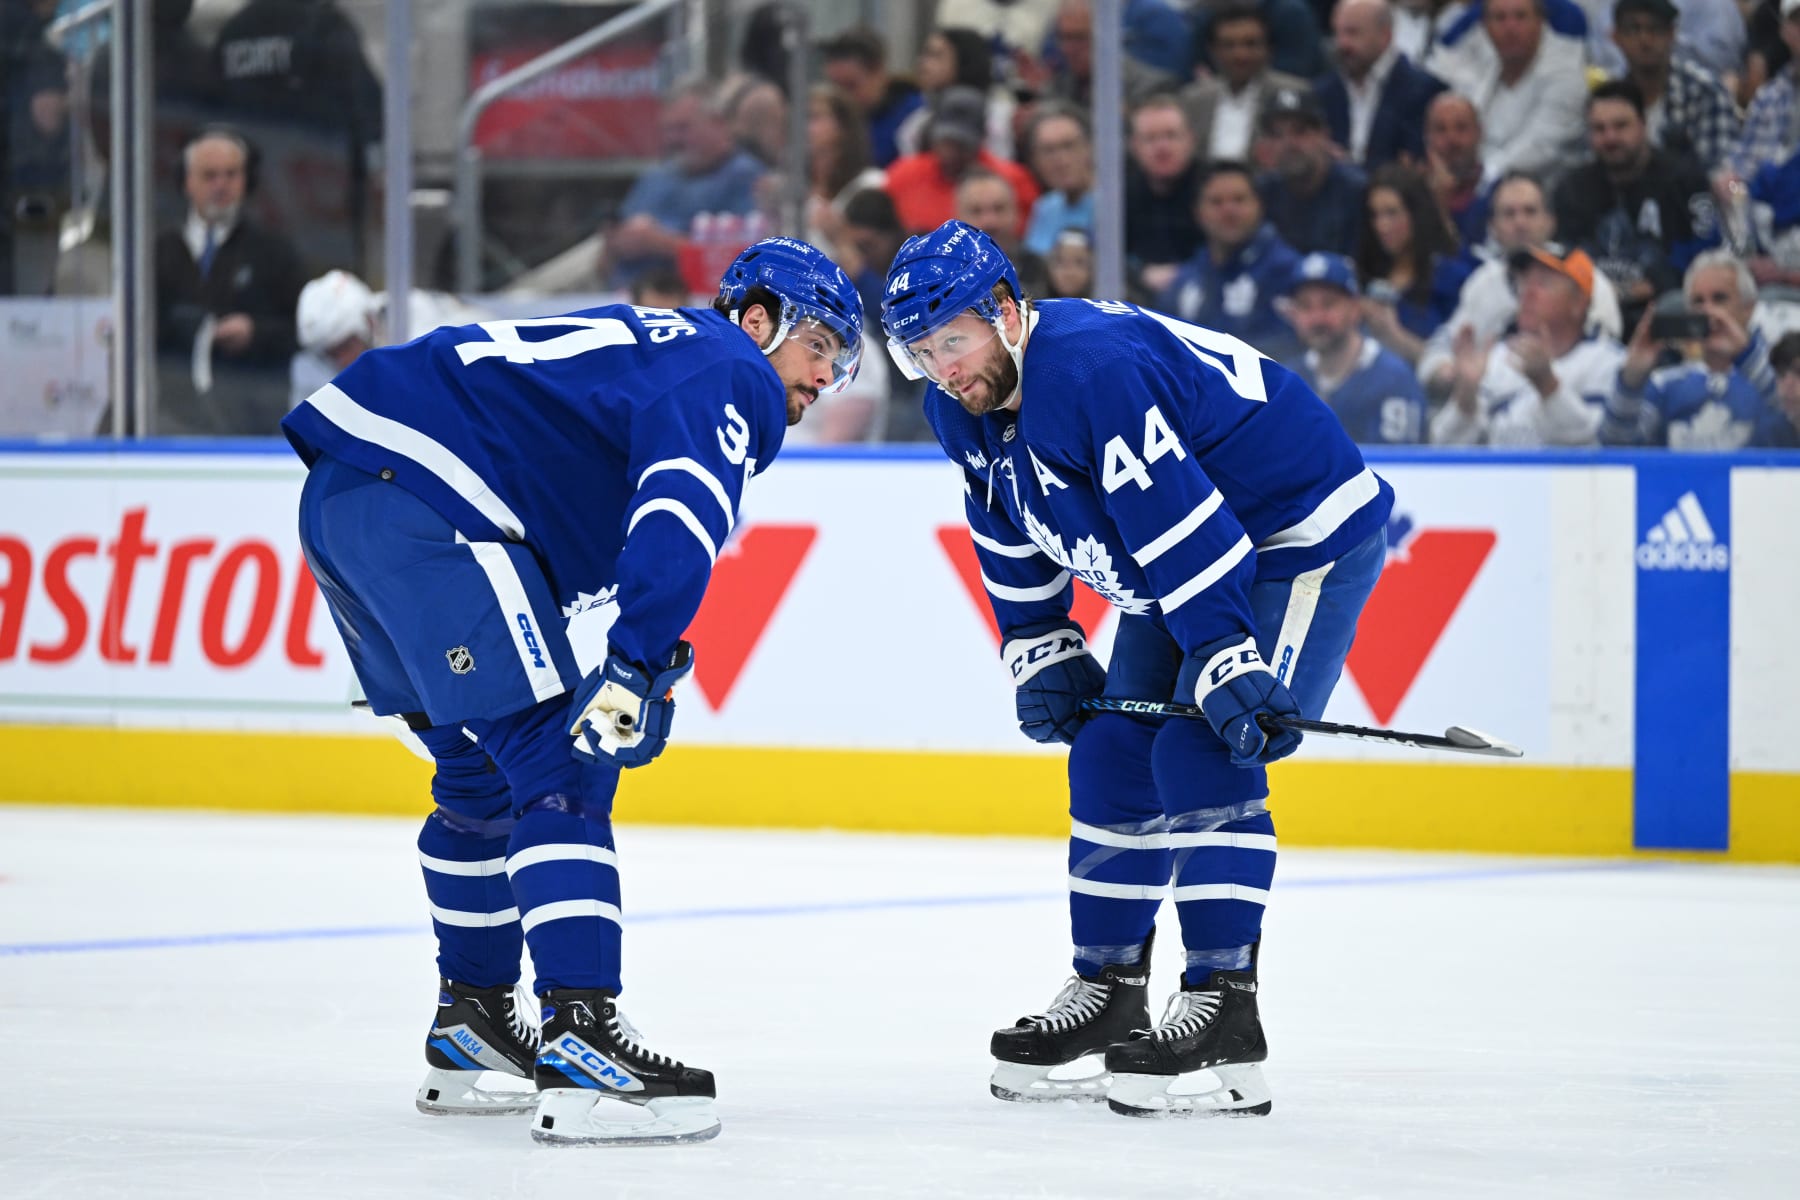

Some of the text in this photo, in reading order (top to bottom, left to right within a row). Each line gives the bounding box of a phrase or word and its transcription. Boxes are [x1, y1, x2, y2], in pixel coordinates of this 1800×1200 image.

[1637, 198, 1662, 239] A
[889, 272, 910, 295] 44
[893, 313, 919, 330] CCM
[1102, 404, 1187, 495] 44
[1027, 445, 1069, 497] A
[1636, 541, 1731, 571] adidas
[516, 612, 547, 669] CCM
[1010, 637, 1083, 679] CCM
[1121, 701, 1165, 714] CCM
[1240, 722, 1250, 750] CCM
[453, 1028, 484, 1056] AM34
[561, 1037, 631, 1088] CCM
